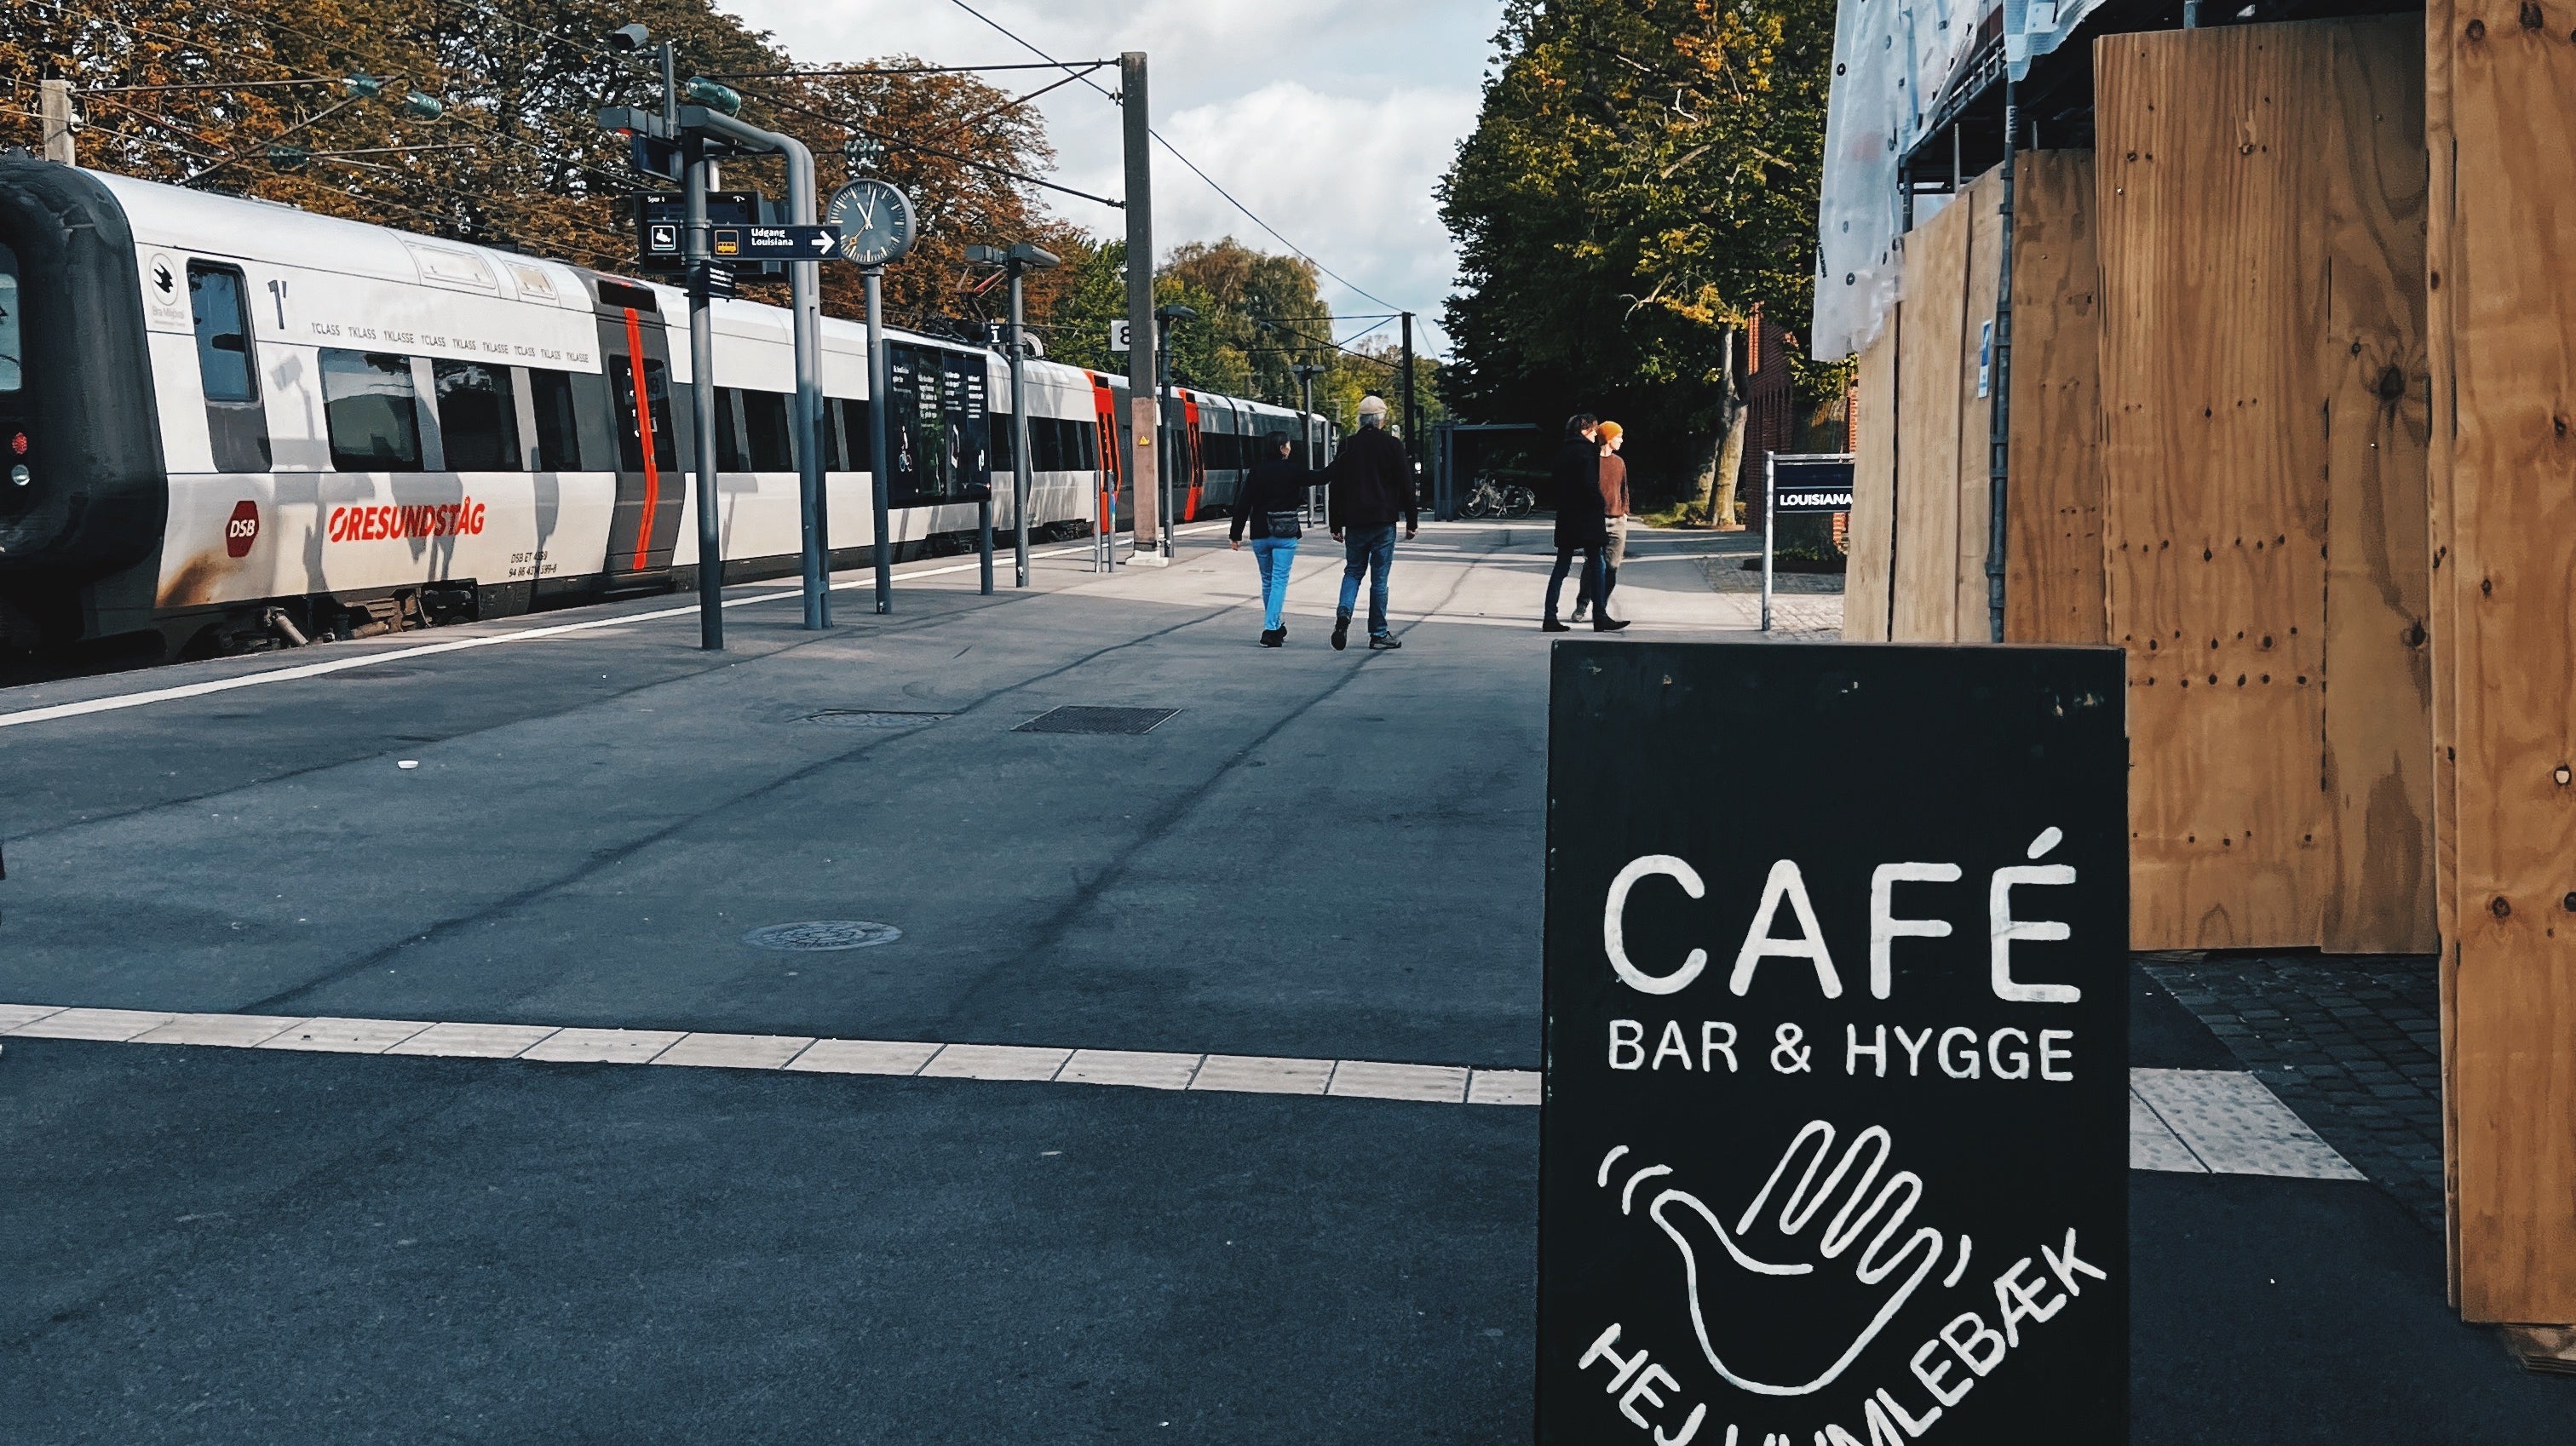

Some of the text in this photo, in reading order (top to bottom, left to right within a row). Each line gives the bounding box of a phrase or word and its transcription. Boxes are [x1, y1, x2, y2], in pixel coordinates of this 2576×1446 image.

[751, 228, 785, 238] Udgang
[751, 238, 794, 246] Louisiana
[1780, 494, 1853, 506] LOUISIANA
[229, 519, 256, 538] DSB
[1603, 826, 2081, 1003] CAFÉ
[1608, 1019, 2074, 1082] BAR & HYGGE
[1578, 1323, 1706, 1446] HEJ
